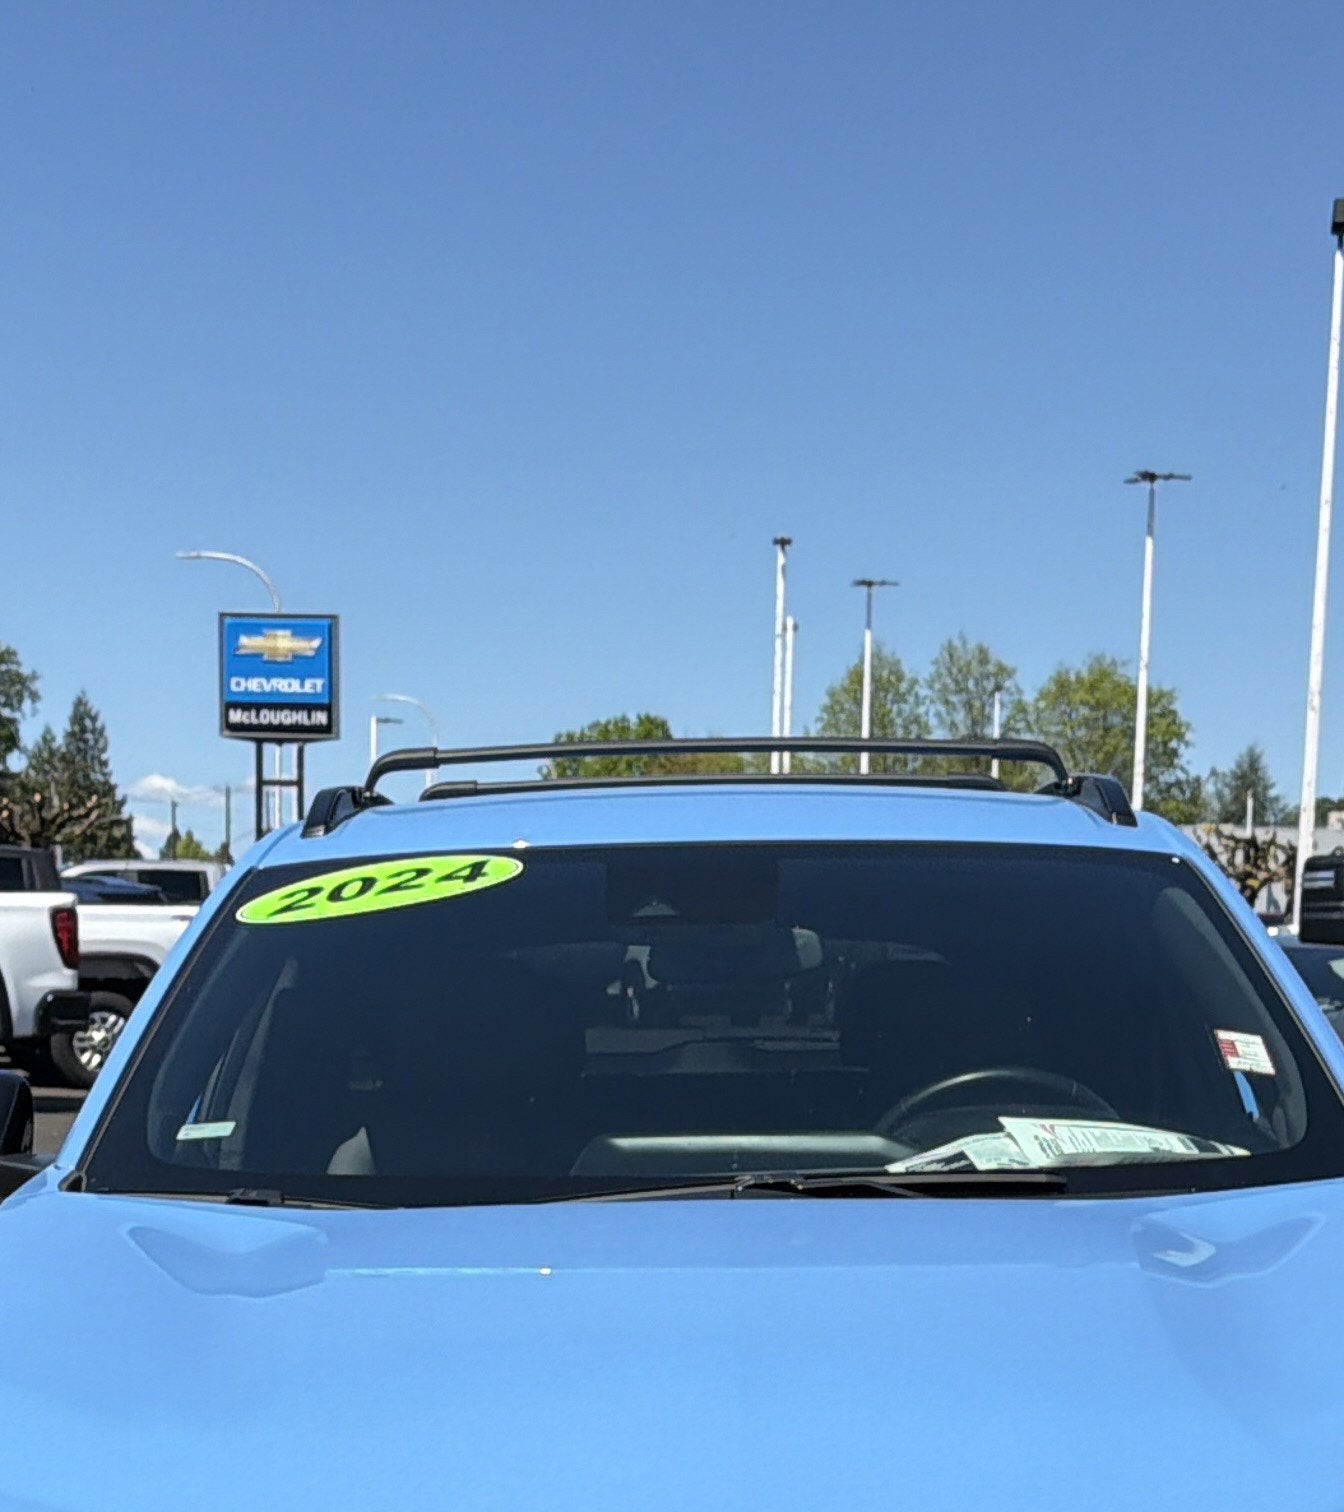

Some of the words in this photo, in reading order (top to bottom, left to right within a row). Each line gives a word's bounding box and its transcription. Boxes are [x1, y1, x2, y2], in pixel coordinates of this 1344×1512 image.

[230, 677, 325, 693] CHEVROLET
[228, 708, 328, 726] McLOUGHLIN
[266, 859, 491, 917] 2024
